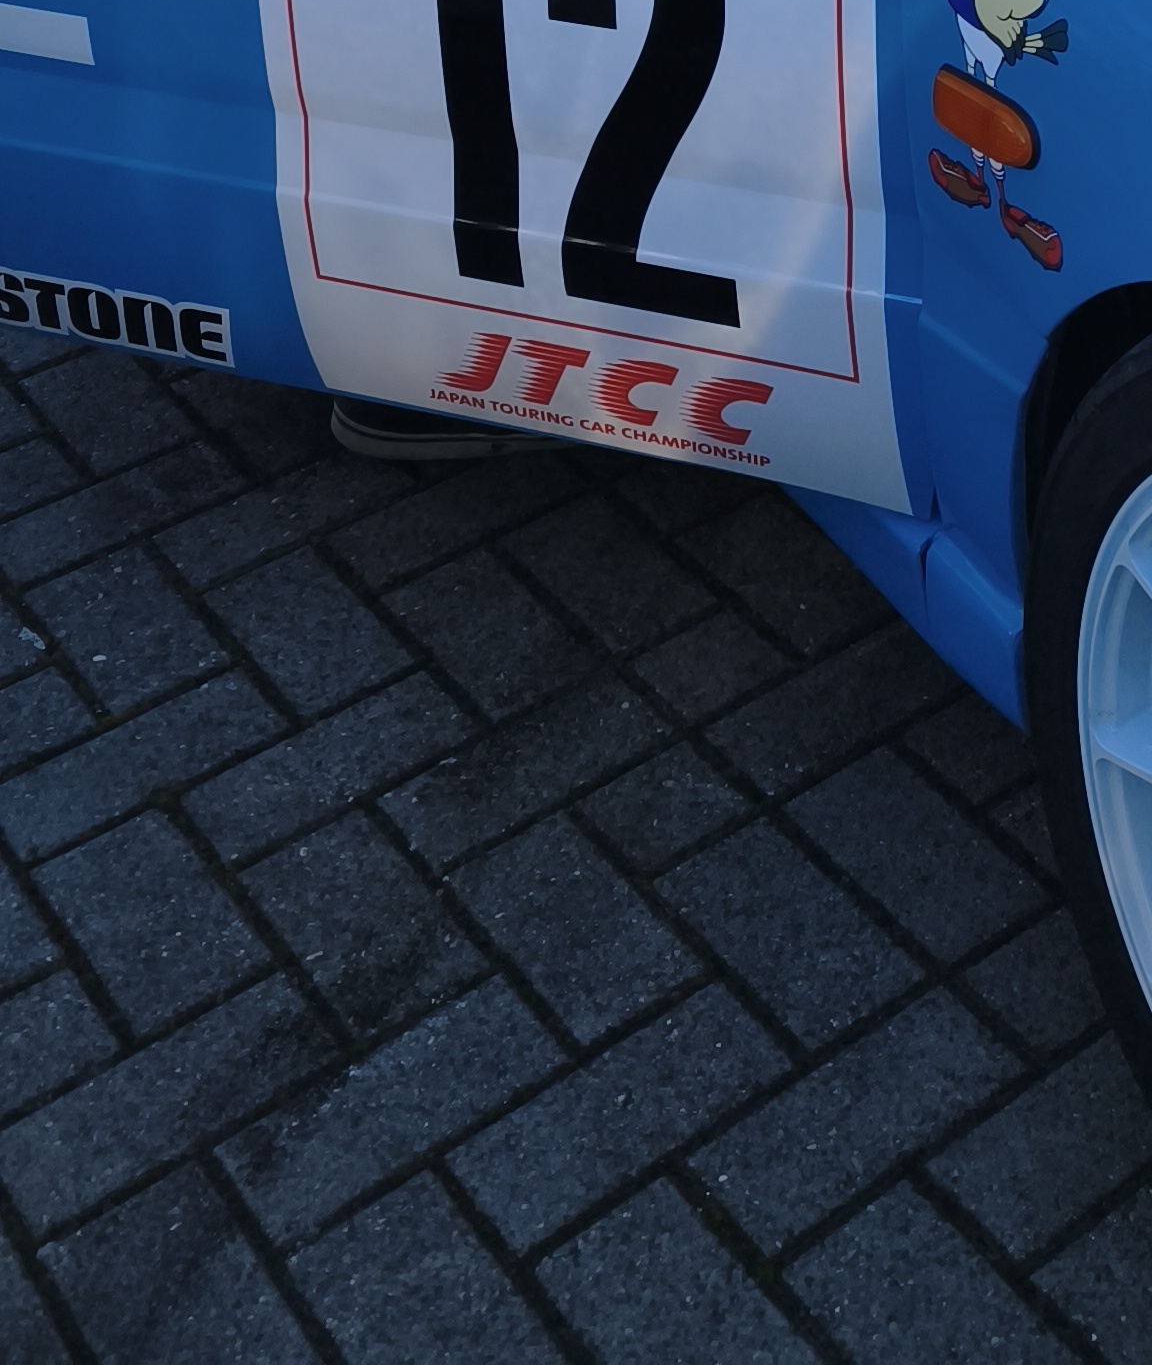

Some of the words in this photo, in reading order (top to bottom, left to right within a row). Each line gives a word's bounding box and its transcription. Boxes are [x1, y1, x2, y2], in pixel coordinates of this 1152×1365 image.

[429, 388, 486, 410] JAPAN
[489, 400, 574, 428] TOURING
[579, 418, 616, 437] CAR
[621, 426, 771, 467] CHAMPIONSHIP
[434, 331, 775, 446] JTCC
